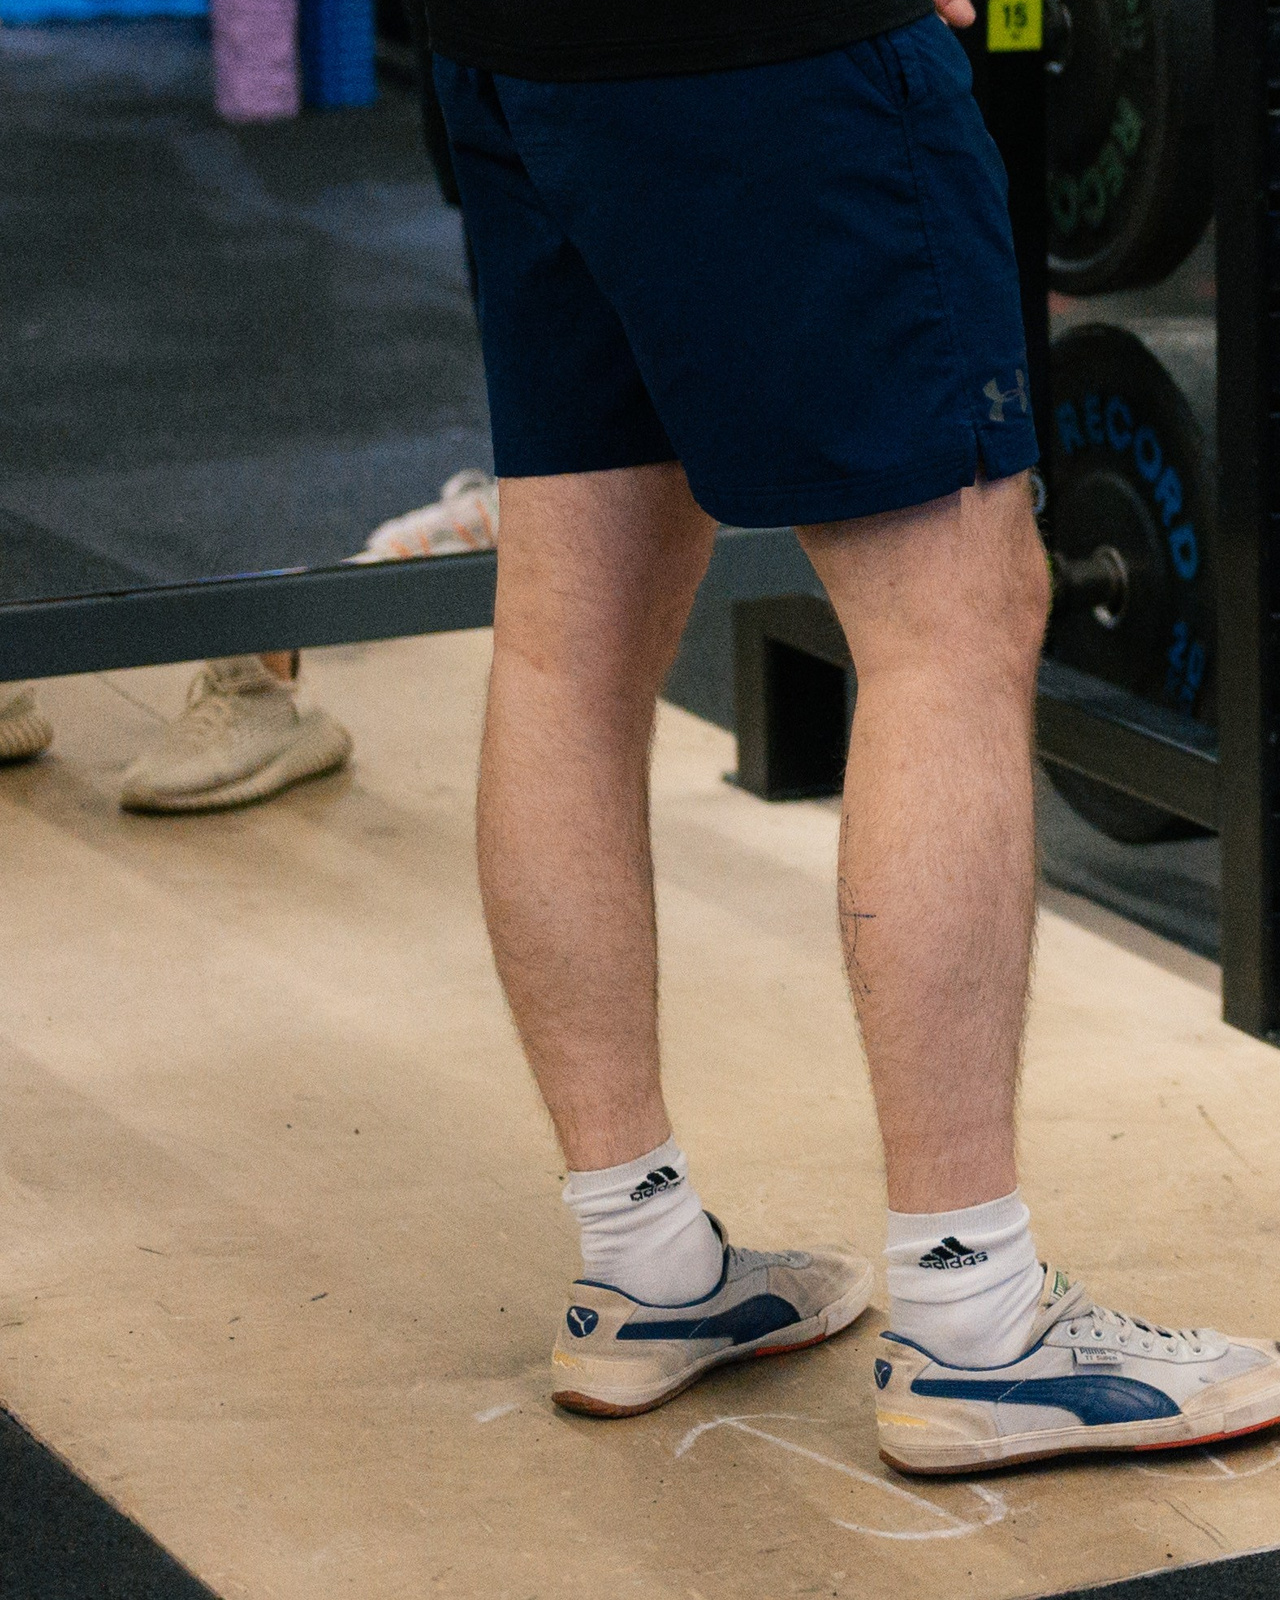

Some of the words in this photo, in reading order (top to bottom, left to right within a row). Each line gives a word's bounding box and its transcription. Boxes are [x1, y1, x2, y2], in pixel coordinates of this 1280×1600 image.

[1003, 1, 1027, 28] 15
[1057, 394, 1199, 581] RECORD
[918, 1252, 988, 1270] adidas
